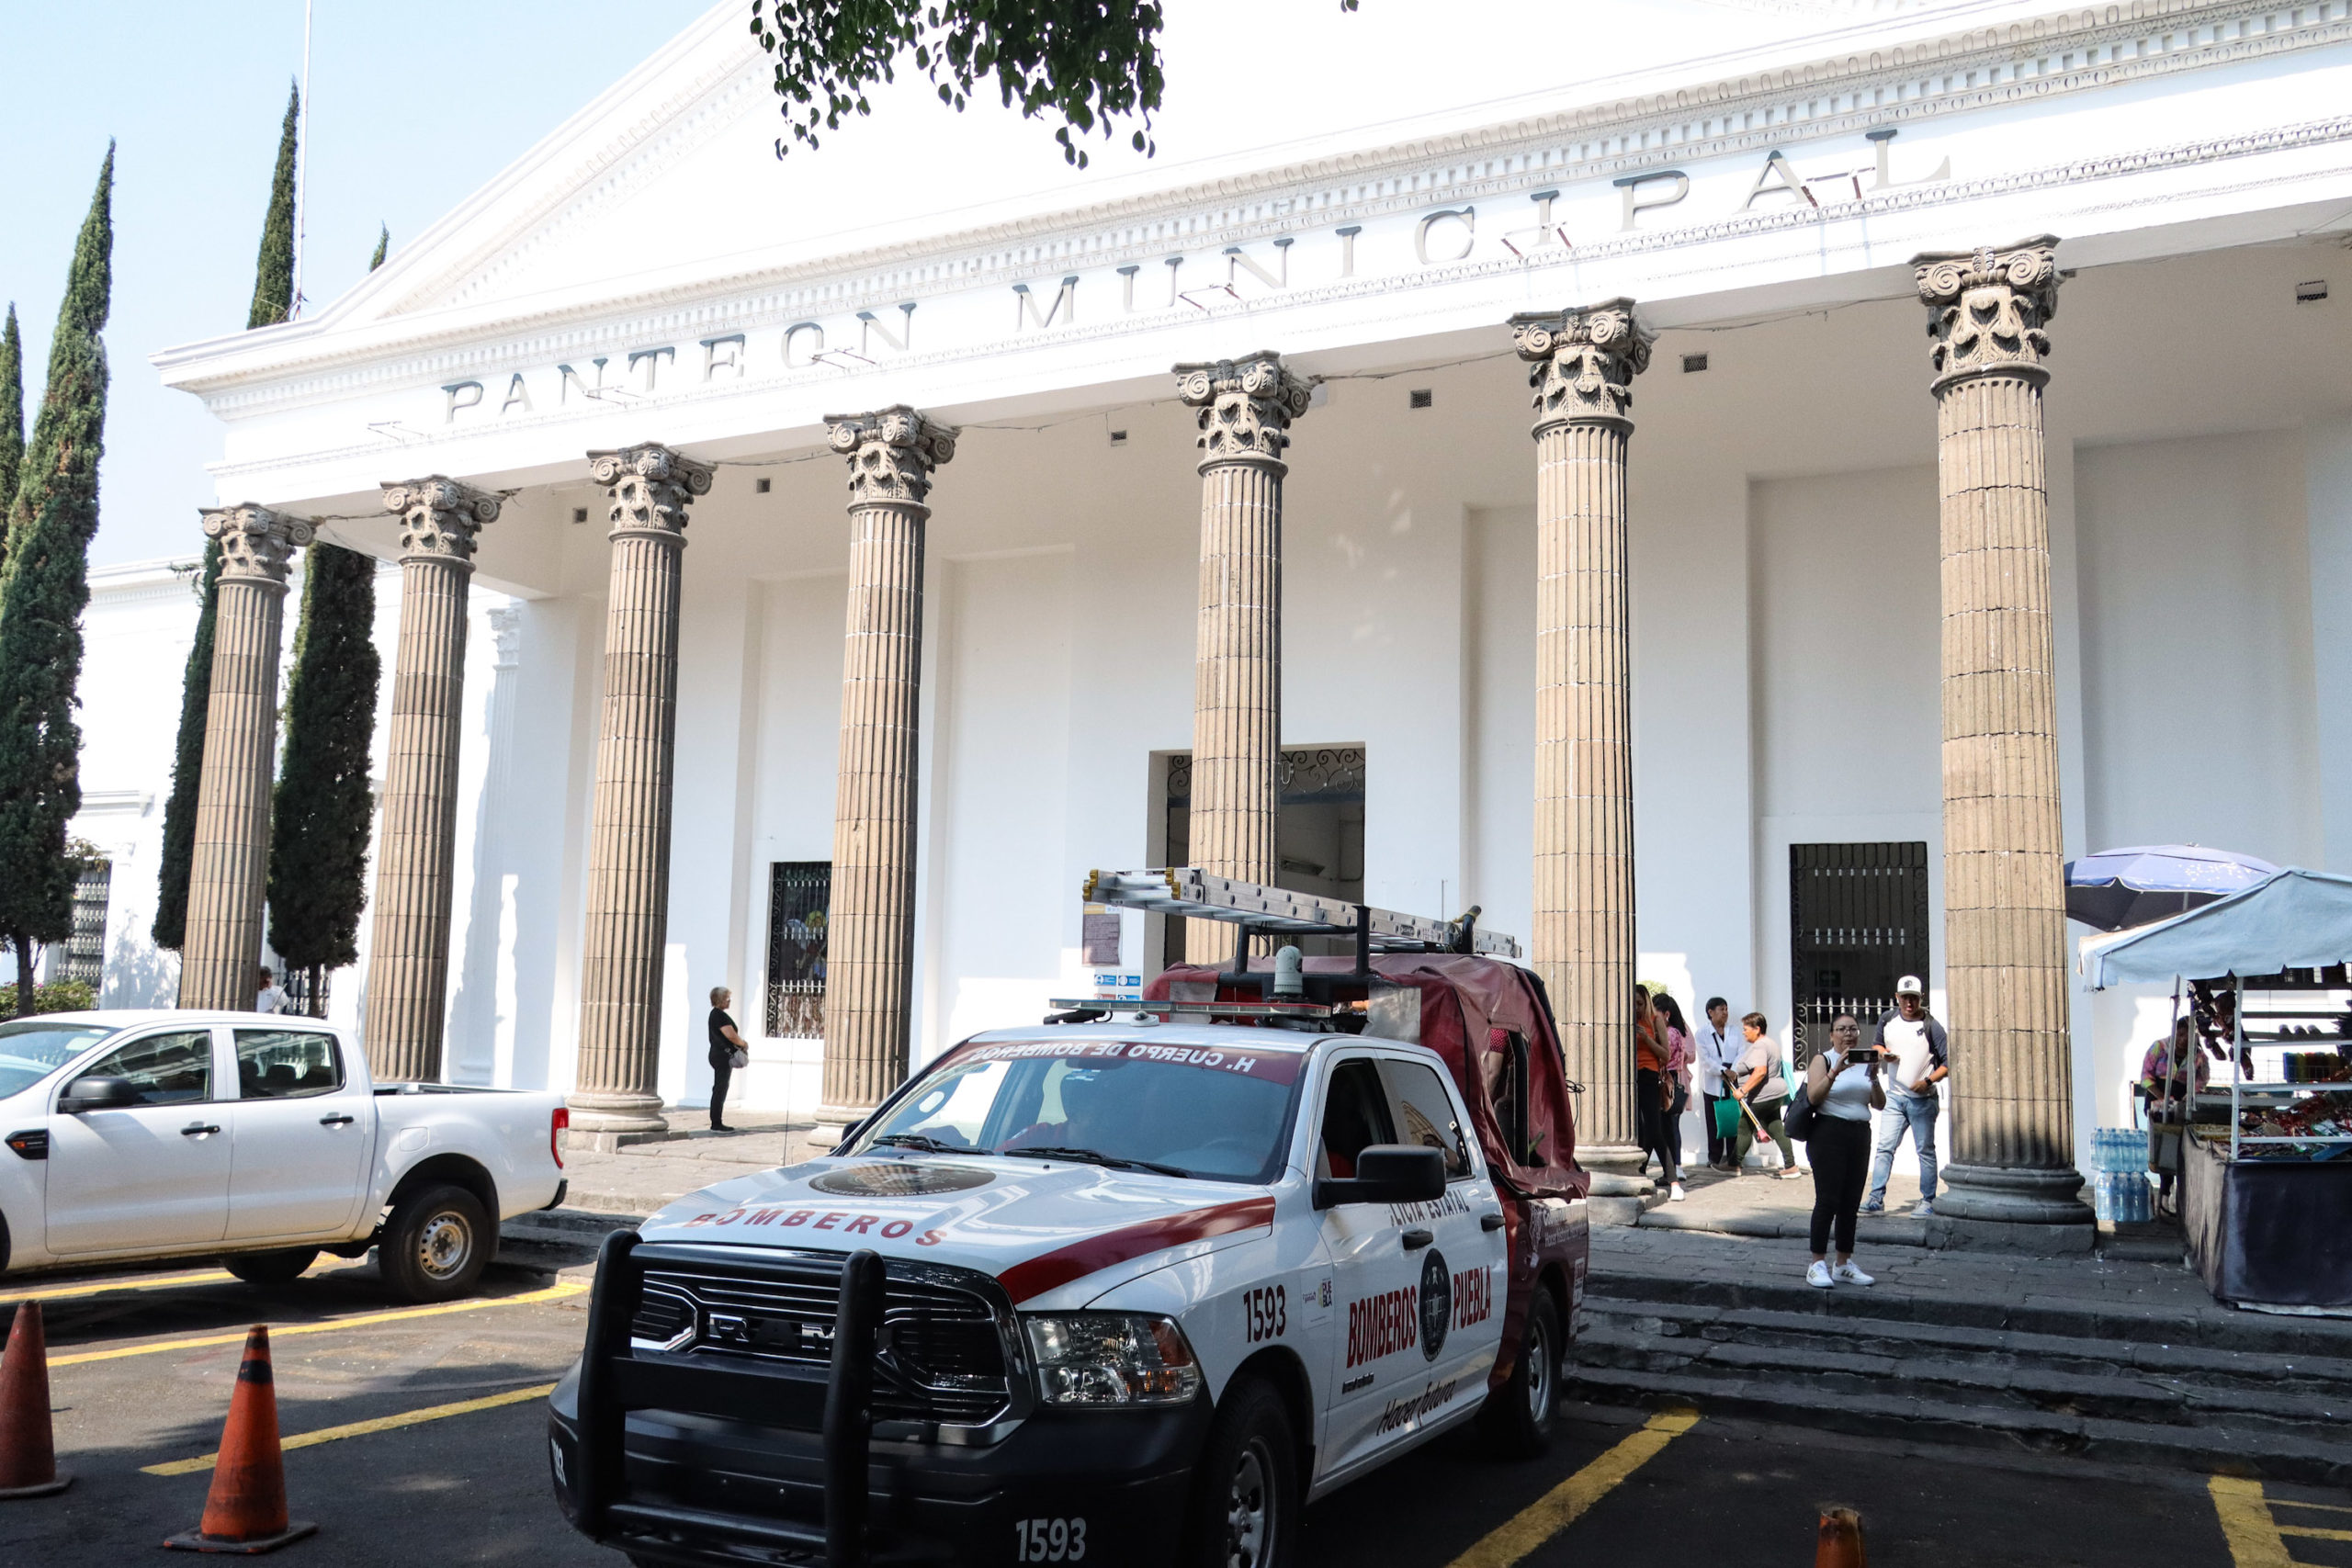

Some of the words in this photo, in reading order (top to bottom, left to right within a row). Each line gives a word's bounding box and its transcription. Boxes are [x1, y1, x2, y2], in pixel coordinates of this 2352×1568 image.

[440, 302, 917, 423] PANTEON
[1012, 128, 1951, 332] MUNICIPAL
[684, 1208, 948, 1247] BOMBEROS
[708, 1313, 836, 1350] RAM
[1243, 1285, 1286, 1344] 1593
[1346, 1284, 1417, 1370] BOMBEROS
[1453, 1265, 1491, 1331] PUEBLA
[1376, 1396, 1422, 1437] Hacer
[1016, 1517, 1087, 1562] 1593
